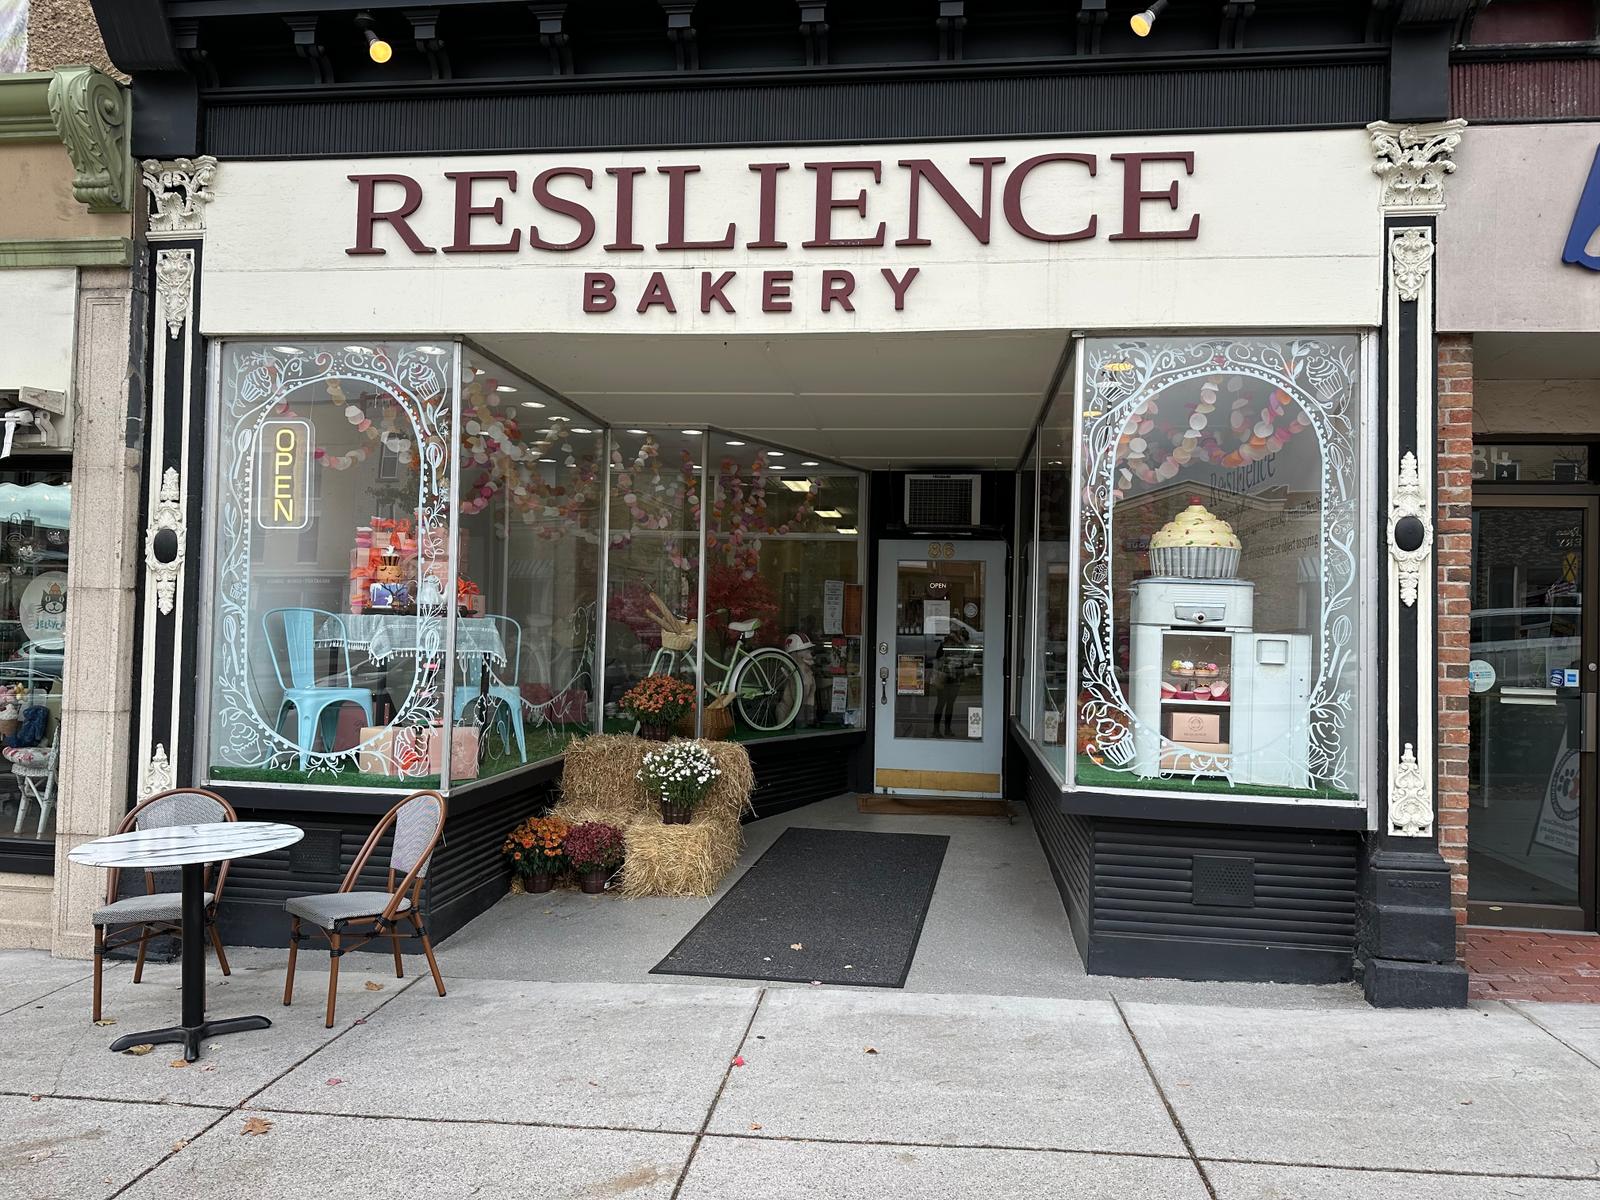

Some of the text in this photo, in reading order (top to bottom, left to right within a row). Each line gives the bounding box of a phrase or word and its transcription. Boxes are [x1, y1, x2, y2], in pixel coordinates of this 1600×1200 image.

[345, 151, 1201, 255] RESILIENCE
[583, 267, 920, 313] BAKERY
[274, 428, 296, 522] OPEN
[928, 542, 955, 559] 86
